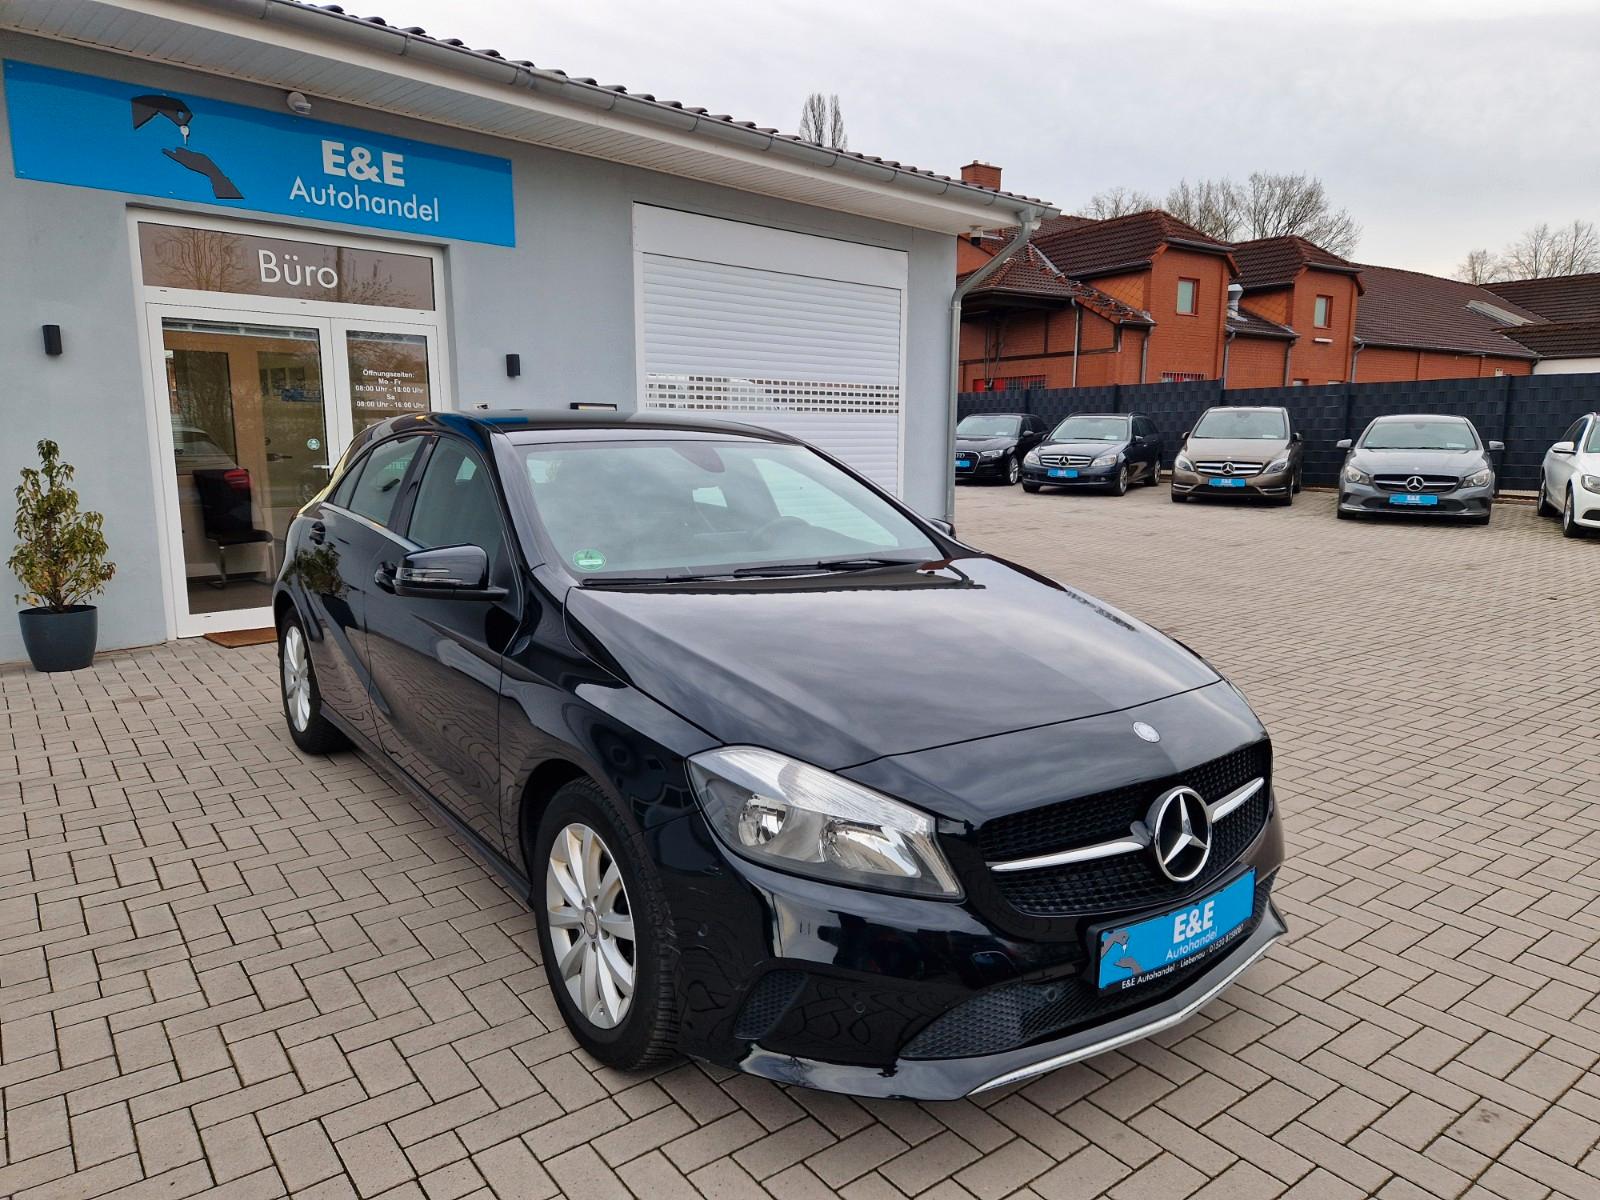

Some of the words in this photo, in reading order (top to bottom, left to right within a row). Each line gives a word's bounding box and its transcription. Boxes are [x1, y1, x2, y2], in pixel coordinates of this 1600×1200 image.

[321, 139, 406, 188] E&E
[289, 175, 439, 223] Autohandel
[257, 249, 339, 289] Büro
[1165, 925, 1218, 961] Autohandel
[1172, 900, 1215, 944] E&E
[1136, 963, 1176, 984] Autohandel
